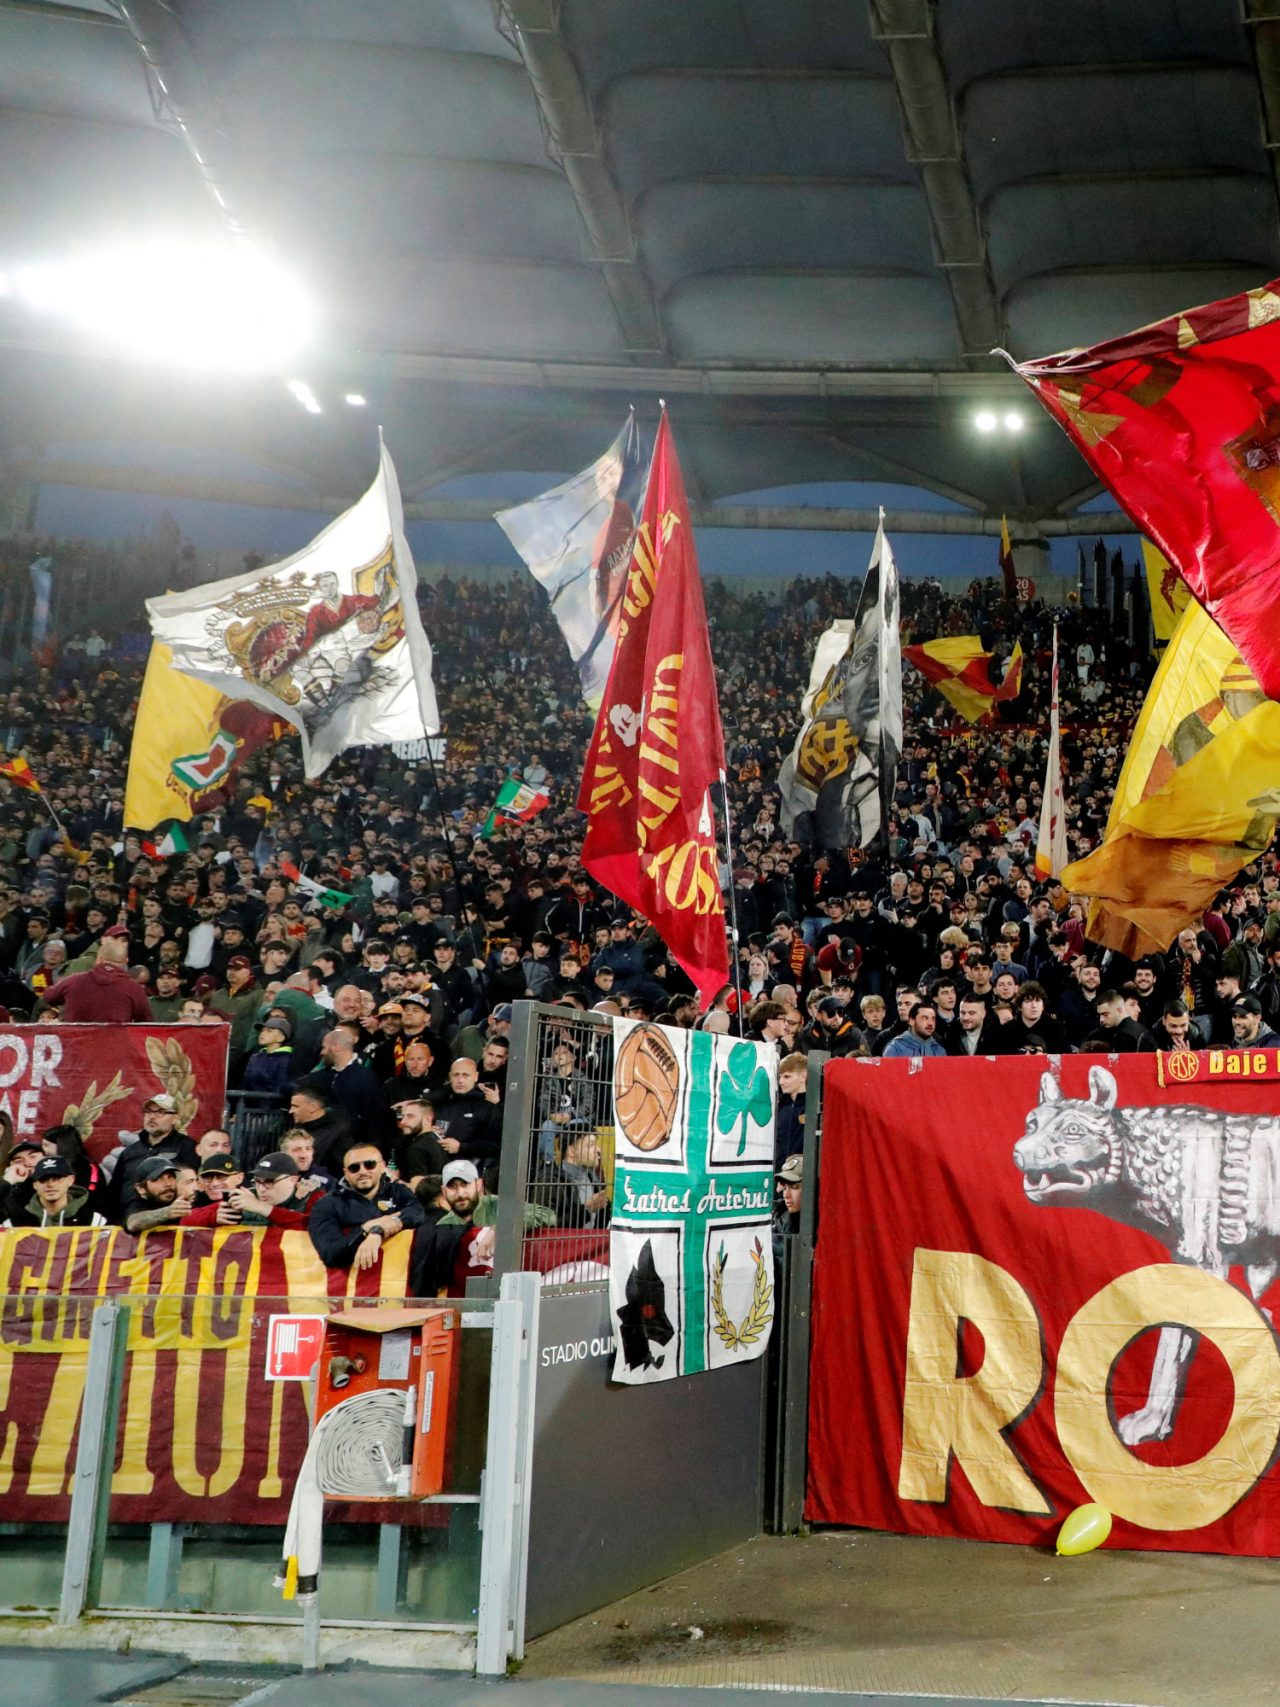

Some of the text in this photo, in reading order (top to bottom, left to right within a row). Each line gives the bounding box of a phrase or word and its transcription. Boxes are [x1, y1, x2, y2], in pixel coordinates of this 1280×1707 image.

[1168, 1051, 1199, 1081] ASR
[1209, 1050, 1267, 1076] Daje
[697, 1178, 770, 1214] Aeterni
[541, 1337, 588, 1367] STADIO
